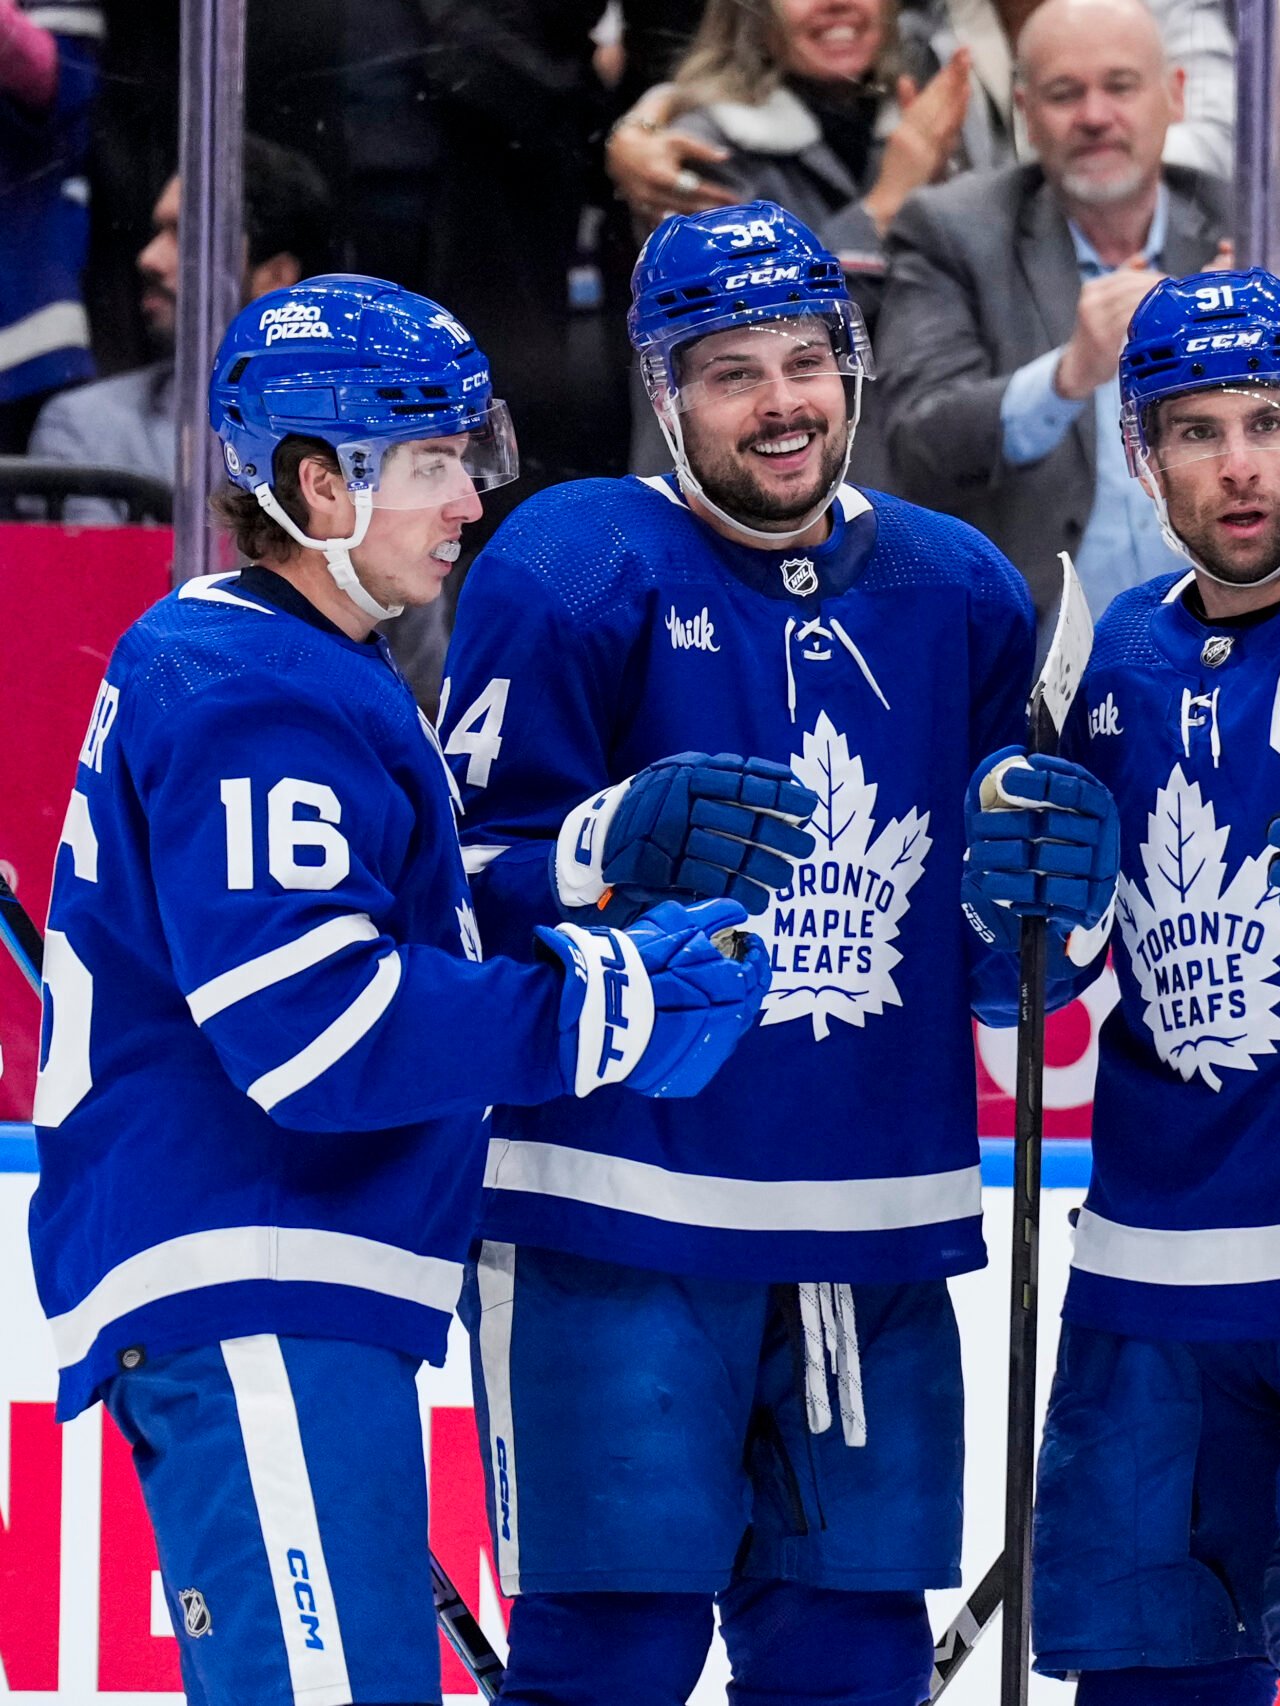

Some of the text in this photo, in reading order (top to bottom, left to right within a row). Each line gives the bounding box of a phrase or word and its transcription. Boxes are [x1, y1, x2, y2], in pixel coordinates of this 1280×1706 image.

[720, 220, 776, 248] 34
[725, 266, 801, 290] CCM
[1196, 285, 1234, 310] 91
[1186, 331, 1263, 352] CCM
[437, 676, 511, 788] 4
[1088, 692, 1124, 740] ilk
[220, 777, 350, 890] 16
[776, 861, 895, 913] RONTO
[774, 908, 875, 938] MAPLE
[1137, 911, 1265, 972] TORONTO
[771, 944, 872, 974] LEAFS
[1154, 953, 1243, 997] MAPLE
[589, 926, 629, 1079] TRU
[1159, 989, 1246, 1032] LEAFS
[496, 1436, 511, 1541] CCM
[286, 1548, 324, 1651] CCM
